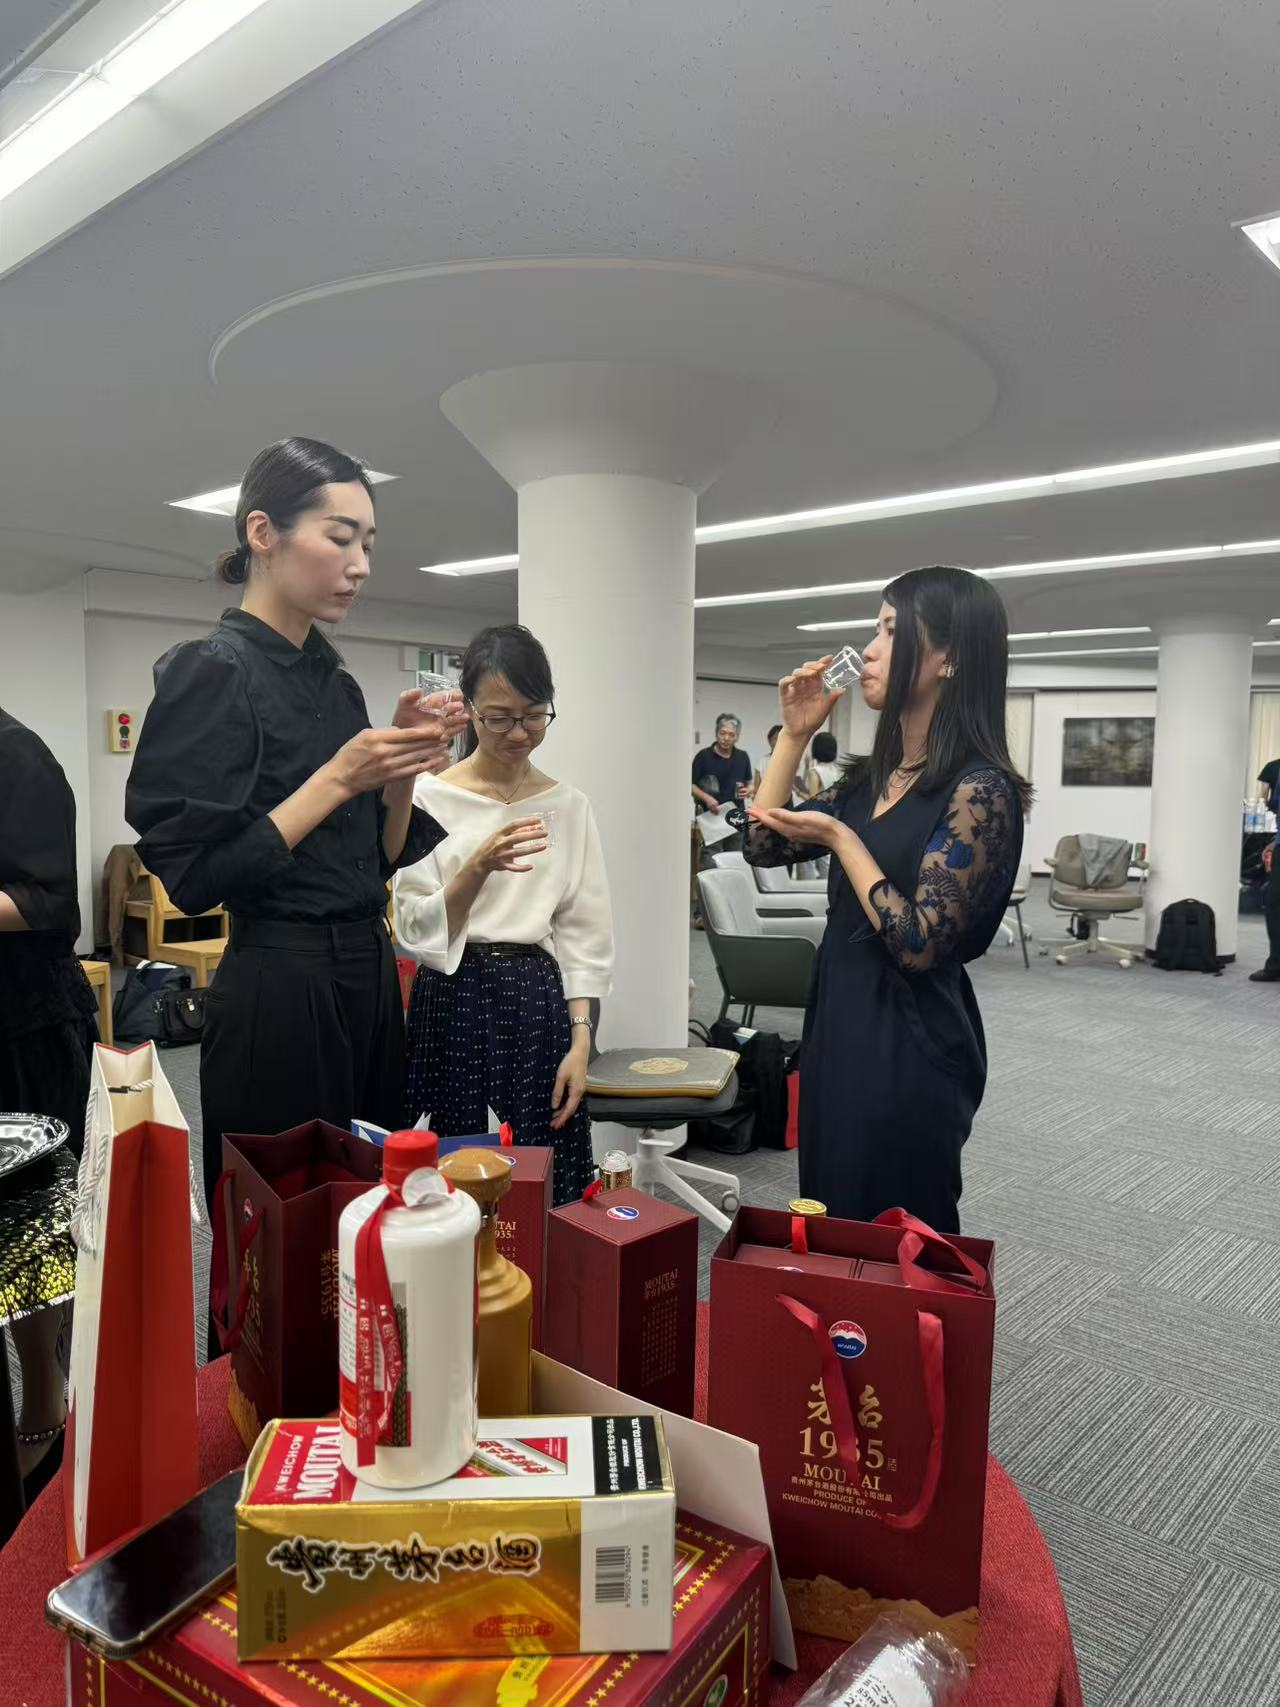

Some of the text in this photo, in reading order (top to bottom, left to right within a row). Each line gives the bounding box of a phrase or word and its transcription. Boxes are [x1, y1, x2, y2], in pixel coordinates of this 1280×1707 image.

[275, 1435, 304, 1493] KWEICHOW
[293, 1425, 342, 1500] MOUTAI
[804, 1462, 880, 1491] MOUAI
[782, 1492, 828, 1509] KWEICHOW
[830, 1502, 864, 1515] MOUTAI
[814, 1489, 854, 1504] PRODUCE
